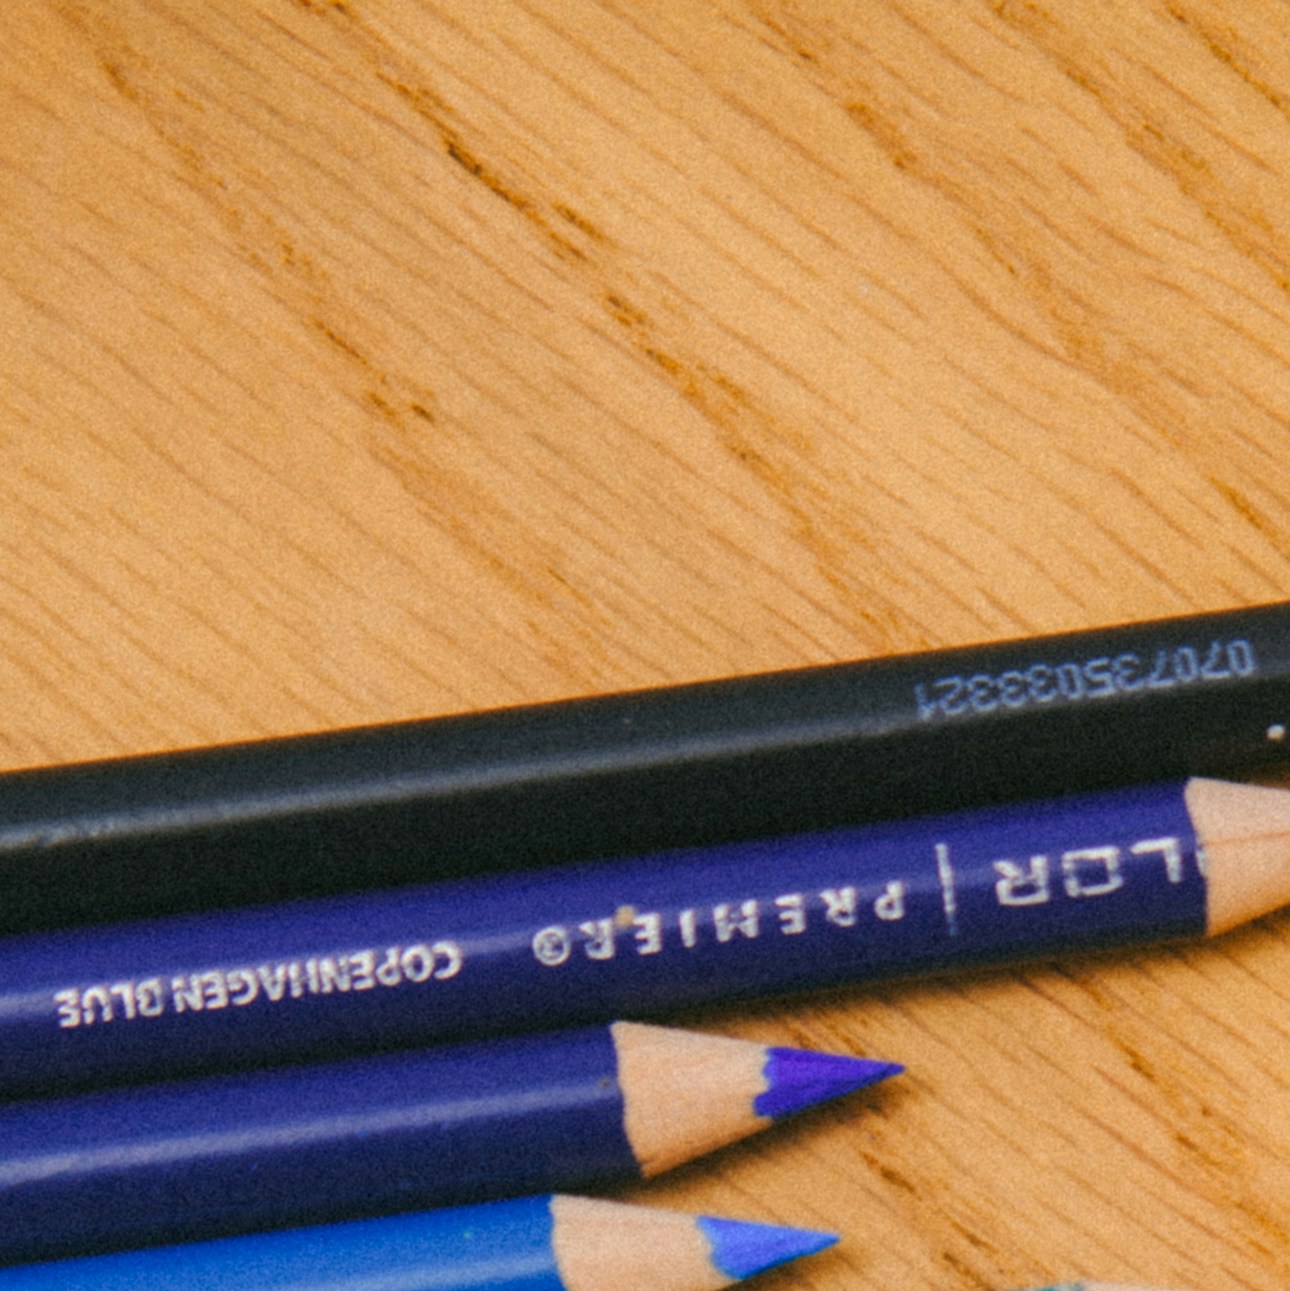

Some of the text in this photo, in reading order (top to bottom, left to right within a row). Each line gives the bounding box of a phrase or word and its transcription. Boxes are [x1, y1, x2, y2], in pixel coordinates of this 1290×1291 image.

[913, 639, 1255, 720] 070735033321
[994, 836, 1207, 906] LOR
[53, 940, 462, 1028] COPENHAGEN BLUE
